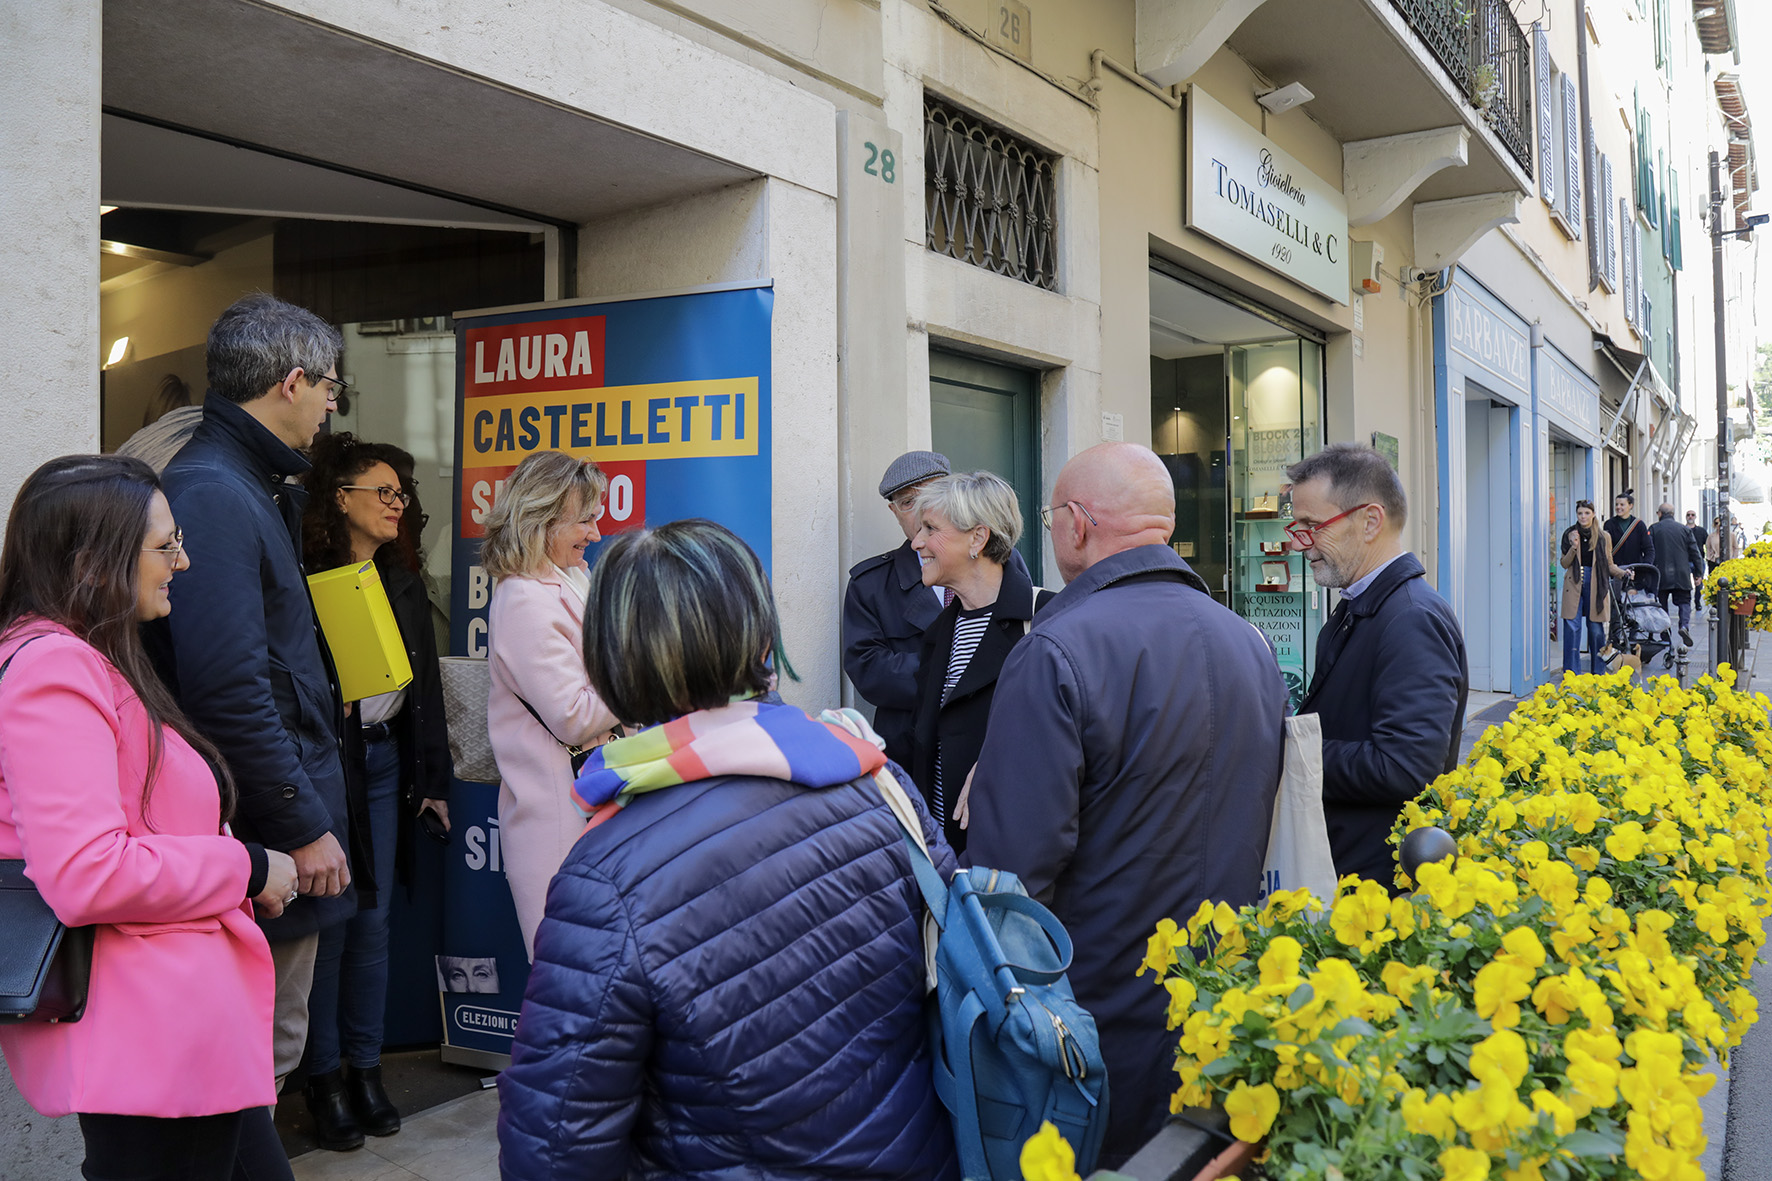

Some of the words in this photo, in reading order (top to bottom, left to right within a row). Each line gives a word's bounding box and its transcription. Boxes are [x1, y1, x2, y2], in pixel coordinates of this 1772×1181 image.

[1000, 6, 1020, 45] 26
[864, 141, 896, 184] 28
[1257, 148, 1307, 207] Gioielleria
[1271, 242, 1292, 264] 1920
[1312, 233, 1323, 256] &
[1326, 234, 1338, 264] C
[474, 330, 592, 384] LAURA
[474, 392, 746, 453] CASTELLETTI
[1253, 429, 1290, 441] BLOCK
[1243, 596, 1294, 606] ACQUISTO
[462, 1011, 508, 1030] ELEZIONI
